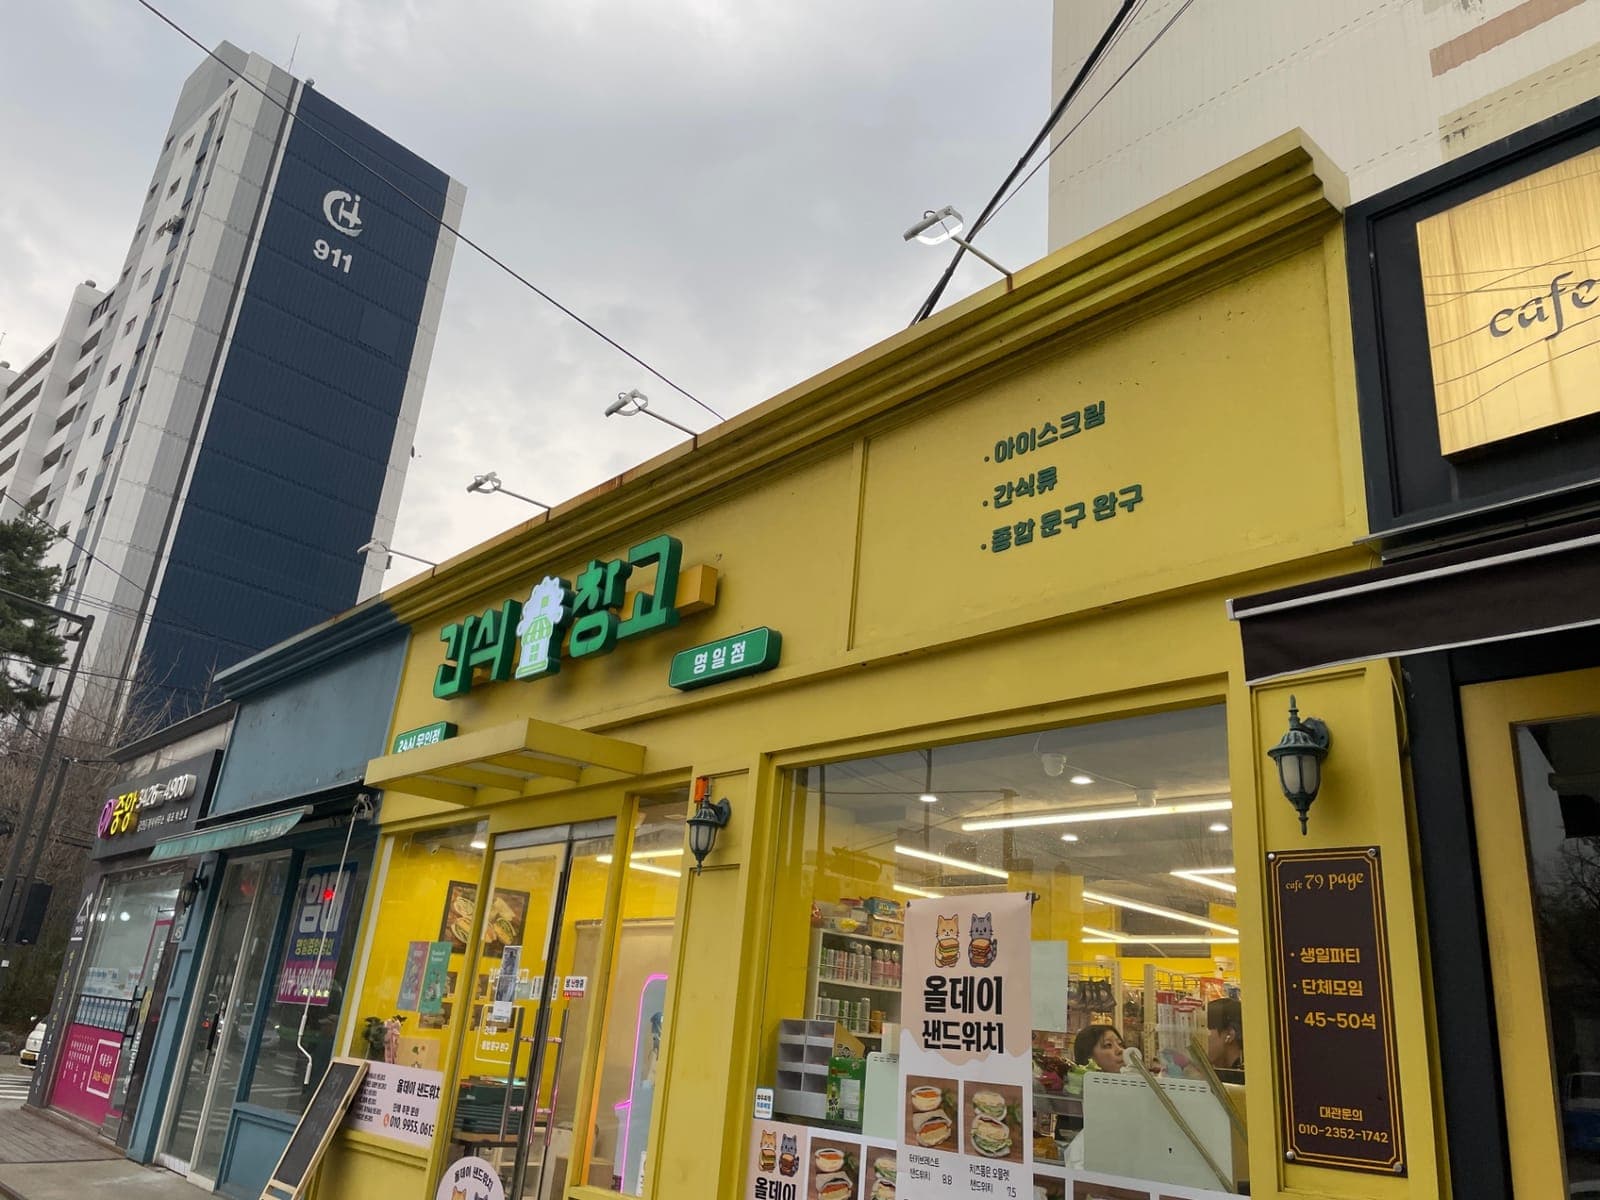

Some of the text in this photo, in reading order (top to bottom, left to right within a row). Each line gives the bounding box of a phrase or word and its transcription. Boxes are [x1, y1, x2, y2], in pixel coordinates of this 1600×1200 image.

[313, 239, 353, 273] 911
[1489, 271, 1600, 341] cafe
[995, 400, 1105, 463] 아이스크림
[994, 466, 1057, 509] 간식류
[991, 483, 1144, 552] 종합 문구 완구
[693, 640, 746, 675] 명일점
[1285, 872, 1364, 893] cafe 79 page
[1300, 947, 1360, 964] 생일파티
[923, 975, 1003, 1015] 올데이
[1302, 979, 1363, 997] 단체모임
[1303, 1011, 1376, 1030] 45~50석
[922, 1020, 1004, 1054] 샌드위치
[396, 1078, 416, 1096] 올데이
[1319, 1106, 1364, 1122] 대관문의
[1298, 1123, 1389, 1144] 010-2352-1742
[454, 1164, 472, 1184] 올데이
[754, 1176, 797, 1200] 올데이
